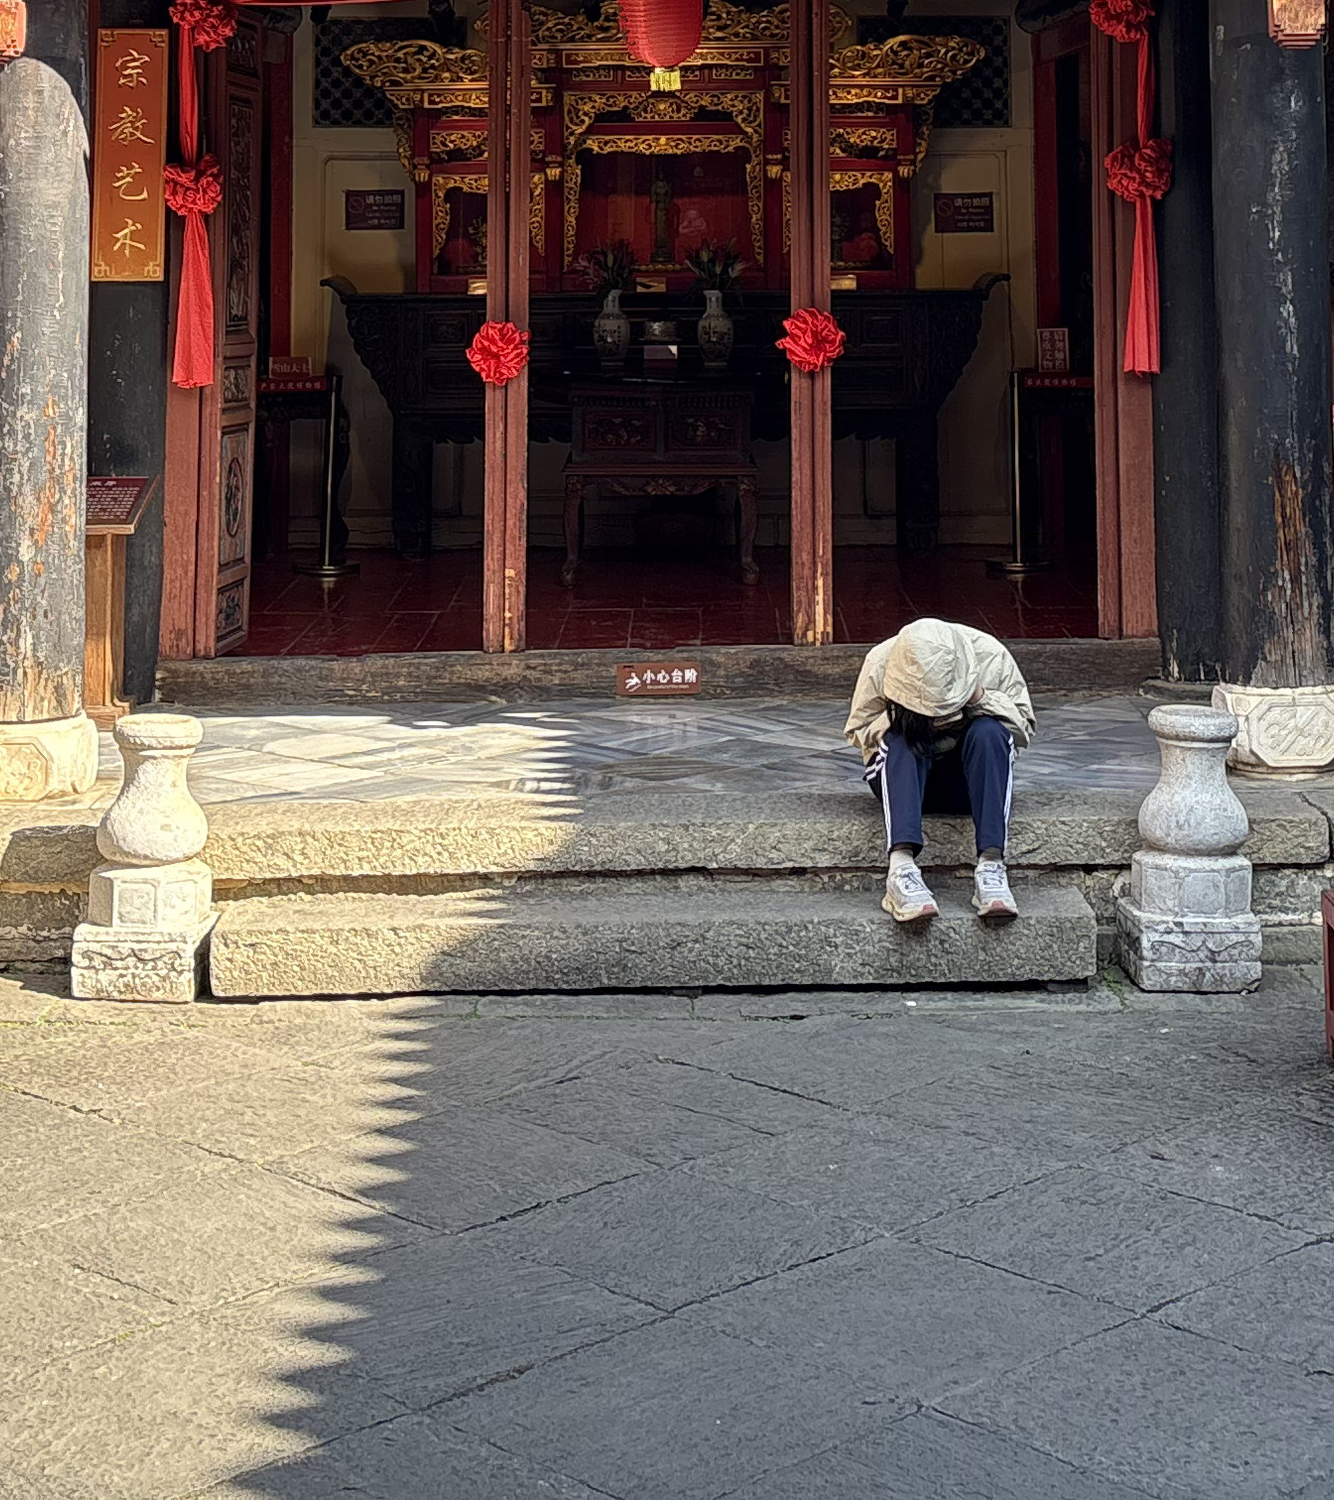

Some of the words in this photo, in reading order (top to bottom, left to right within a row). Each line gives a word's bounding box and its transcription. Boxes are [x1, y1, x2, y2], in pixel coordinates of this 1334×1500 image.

[108, 49, 155, 258] 宗教艺术
[642, 668, 698, 684] 小心台阶
